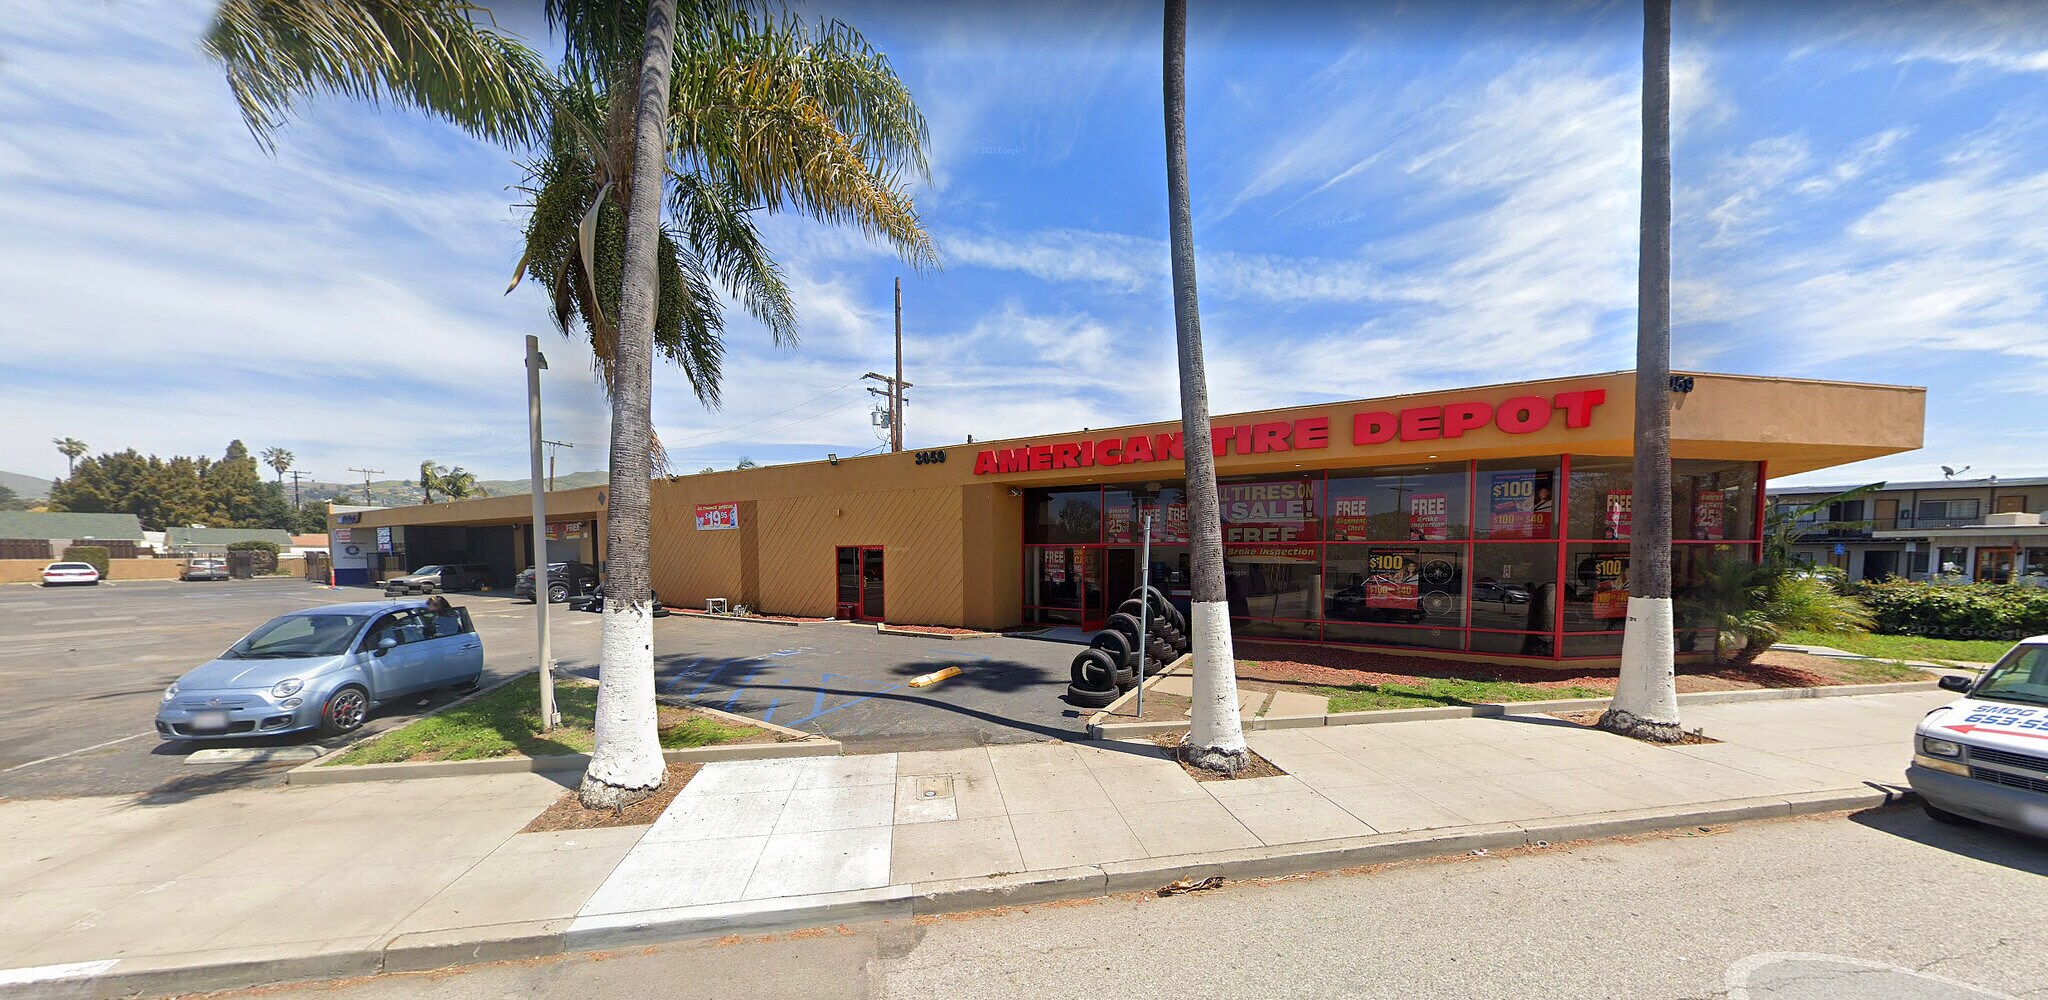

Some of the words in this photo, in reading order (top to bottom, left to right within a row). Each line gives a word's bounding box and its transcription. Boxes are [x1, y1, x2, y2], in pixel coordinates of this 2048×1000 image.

[973, 432, 1185, 475] AMERICAN
[1211, 416, 1329, 457] TIRE
[1353, 389, 1606, 446] DEPOT
[915, 450, 946, 465] 3059
[1230, 483, 1297, 501] TIRES
[1297, 483, 1313, 499] ON
[1493, 480, 1533, 498] $100
[1230, 500, 1313, 520] SALE!
[1335, 500, 1367, 516] FREE
[1411, 497, 1445, 515] FREE
[1606, 494, 1632, 512] FREE
[1168, 506, 1188, 521] FRE
[1336, 517, 1367, 525] Alignment
[1493, 513, 1515, 525] $100
[1525, 513, 1544, 524] $40
[1227, 526, 1298, 546] FREE
[1044, 550, 1065, 563] FREE
[1227, 547, 1257, 556] Brake
[1259, 547, 1315, 557] Inspection
[1369, 555, 1403, 570] $100
[1595, 560, 1622, 576] $100
[1973, 705, 2039, 716] SMOG
